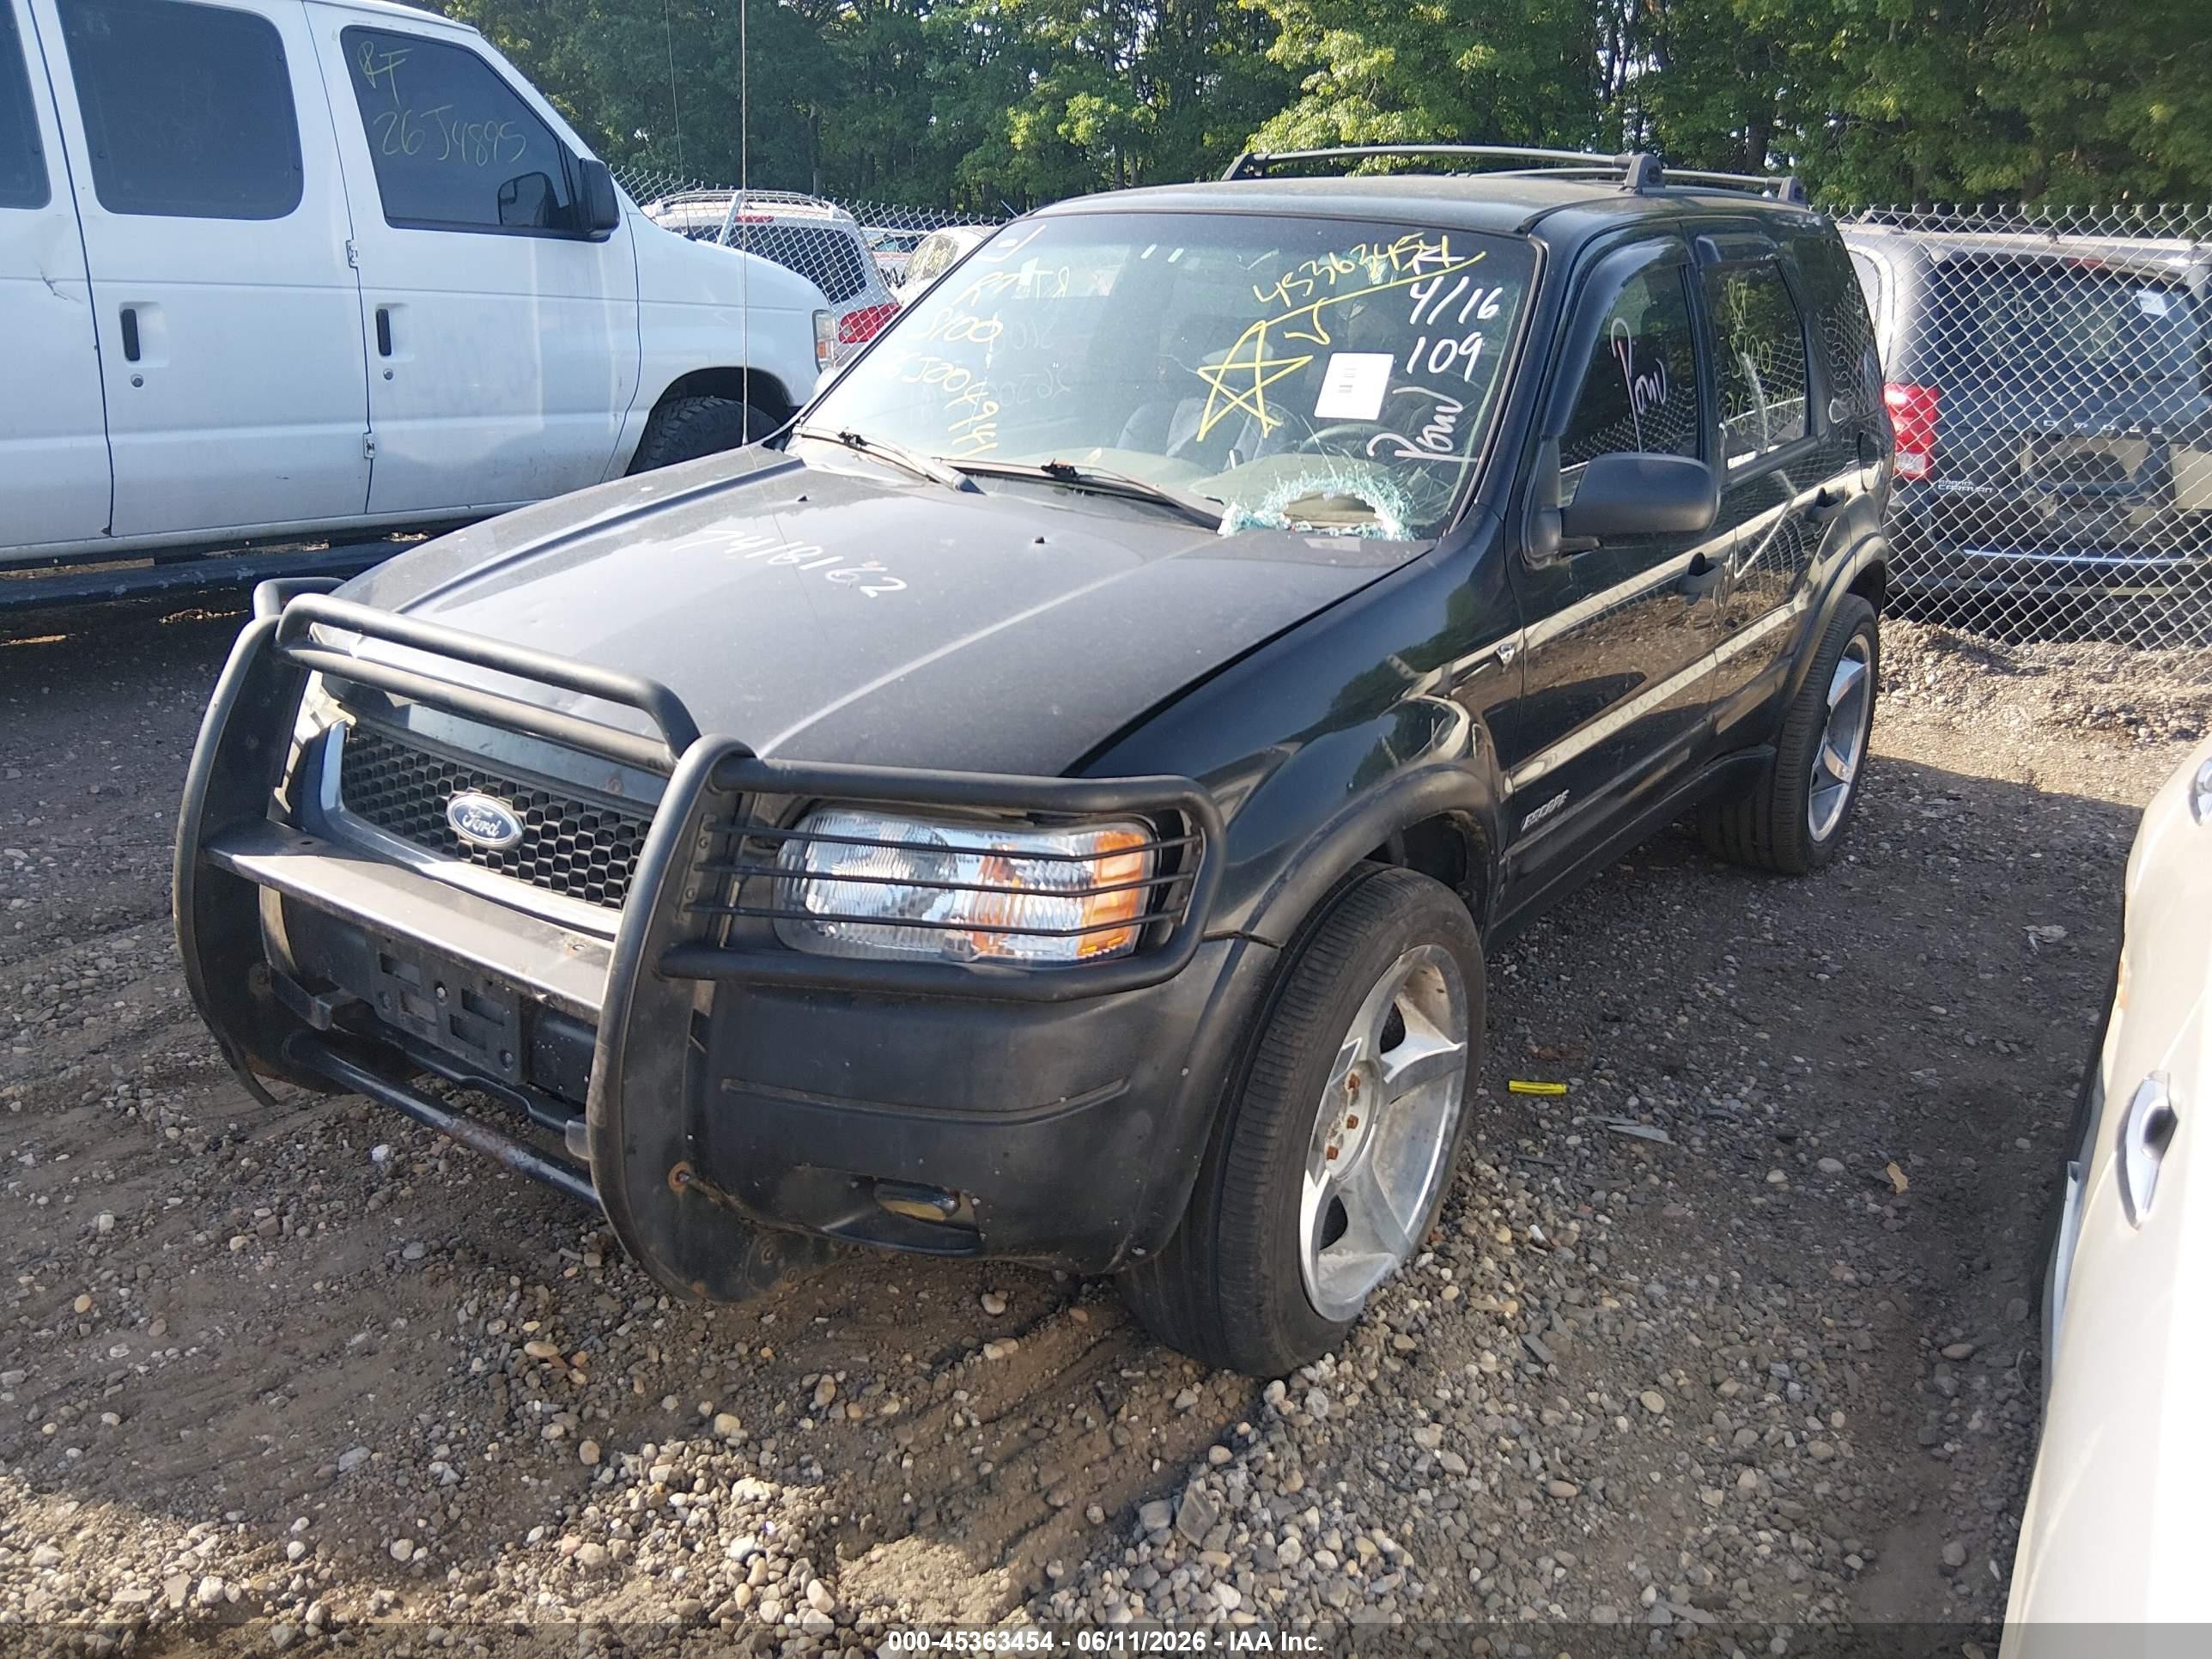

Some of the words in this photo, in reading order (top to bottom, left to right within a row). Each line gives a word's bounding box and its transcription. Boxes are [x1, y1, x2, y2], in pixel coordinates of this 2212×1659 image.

[1409, 276, 1504, 325] 4/16
[1406, 331, 1484, 383] 109
[462, 805, 502, 837] Ford
